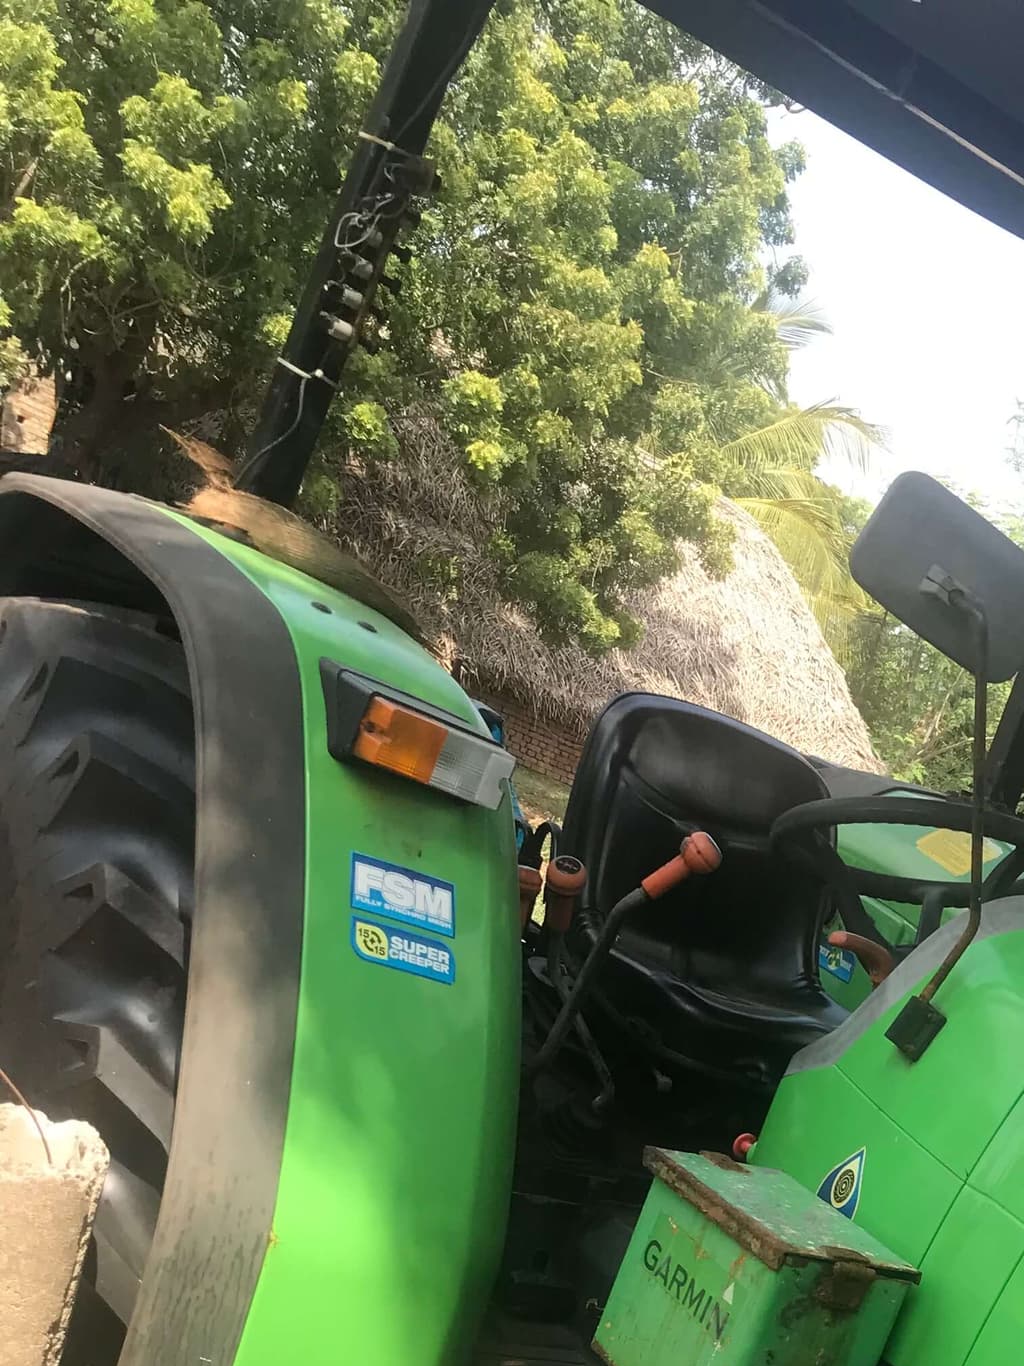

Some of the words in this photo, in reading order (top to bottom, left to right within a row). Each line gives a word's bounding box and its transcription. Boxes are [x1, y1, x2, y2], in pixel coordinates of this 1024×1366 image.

[355, 861, 452, 922] FSM
[356, 895, 382, 906] FULLY
[358, 928, 369, 939] 15
[375, 946, 385, 956] 15
[389, 948, 449, 974] CREEPER
[391, 936, 449, 964] SUPER
[644, 1240, 730, 1340] GARMIN
